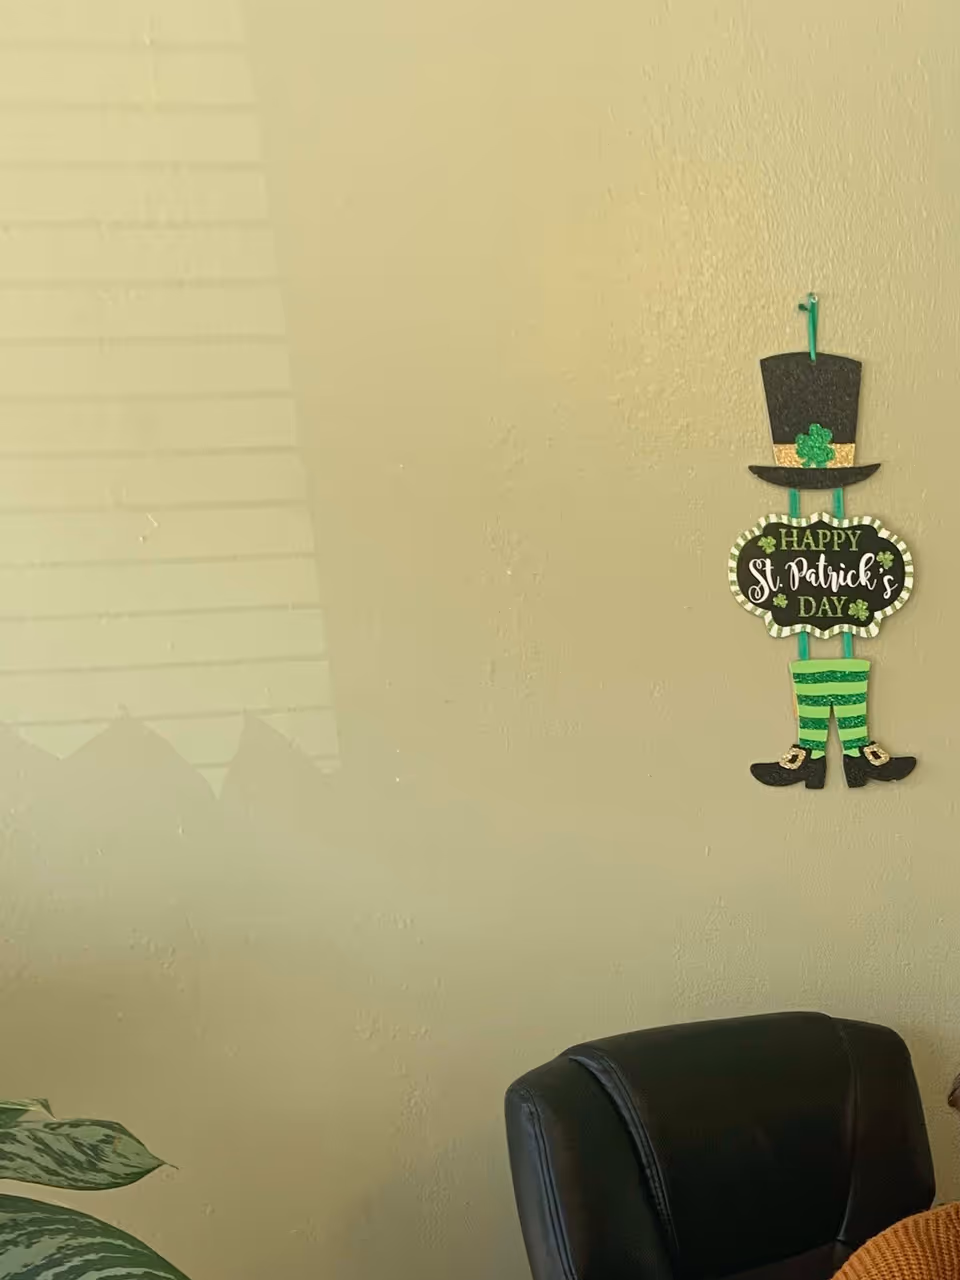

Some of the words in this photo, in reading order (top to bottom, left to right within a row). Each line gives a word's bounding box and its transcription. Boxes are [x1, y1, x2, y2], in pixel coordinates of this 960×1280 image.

[779, 528, 862, 551] HAPPY
[748, 558, 783, 604] St.
[785, 553, 898, 599] Patrick's
[797, 596, 849, 617] DAY
